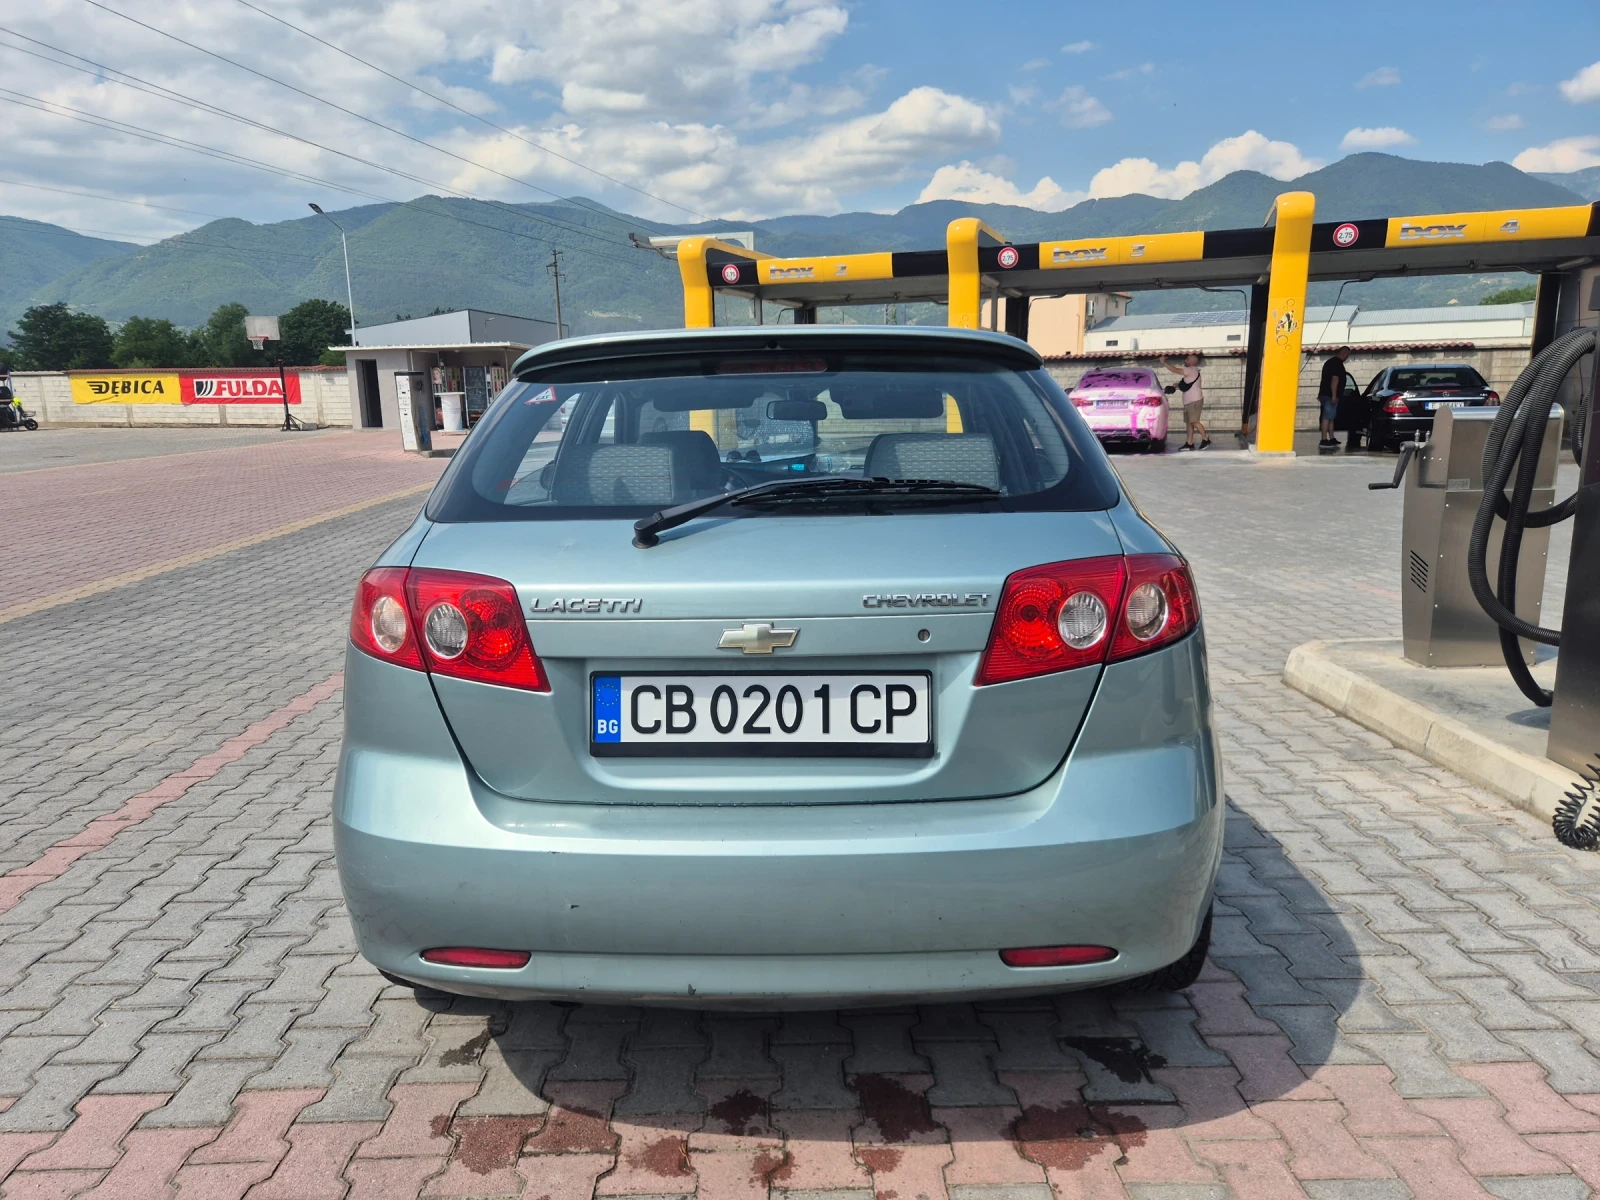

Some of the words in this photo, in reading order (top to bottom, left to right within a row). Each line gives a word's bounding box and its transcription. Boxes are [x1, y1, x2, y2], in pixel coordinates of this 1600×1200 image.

[1338, 231, 1353, 240] 2.75
[1399, 222, 1467, 239] box
[1500, 218, 1521, 234] 4
[1052, 247, 1107, 263] box
[1130, 243, 1145, 257] 3
[770, 265, 814, 279] box
[835, 264, 848, 276] 2
[213, 380, 284, 397] FULDA
[530, 598, 642, 613] LACETTI
[862, 592, 991, 608] CHEVROLET
[630, 684, 697, 734] CB
[709, 684, 830, 734] 0201
[849, 684, 917, 734] CP
[597, 719, 619, 734] BG
